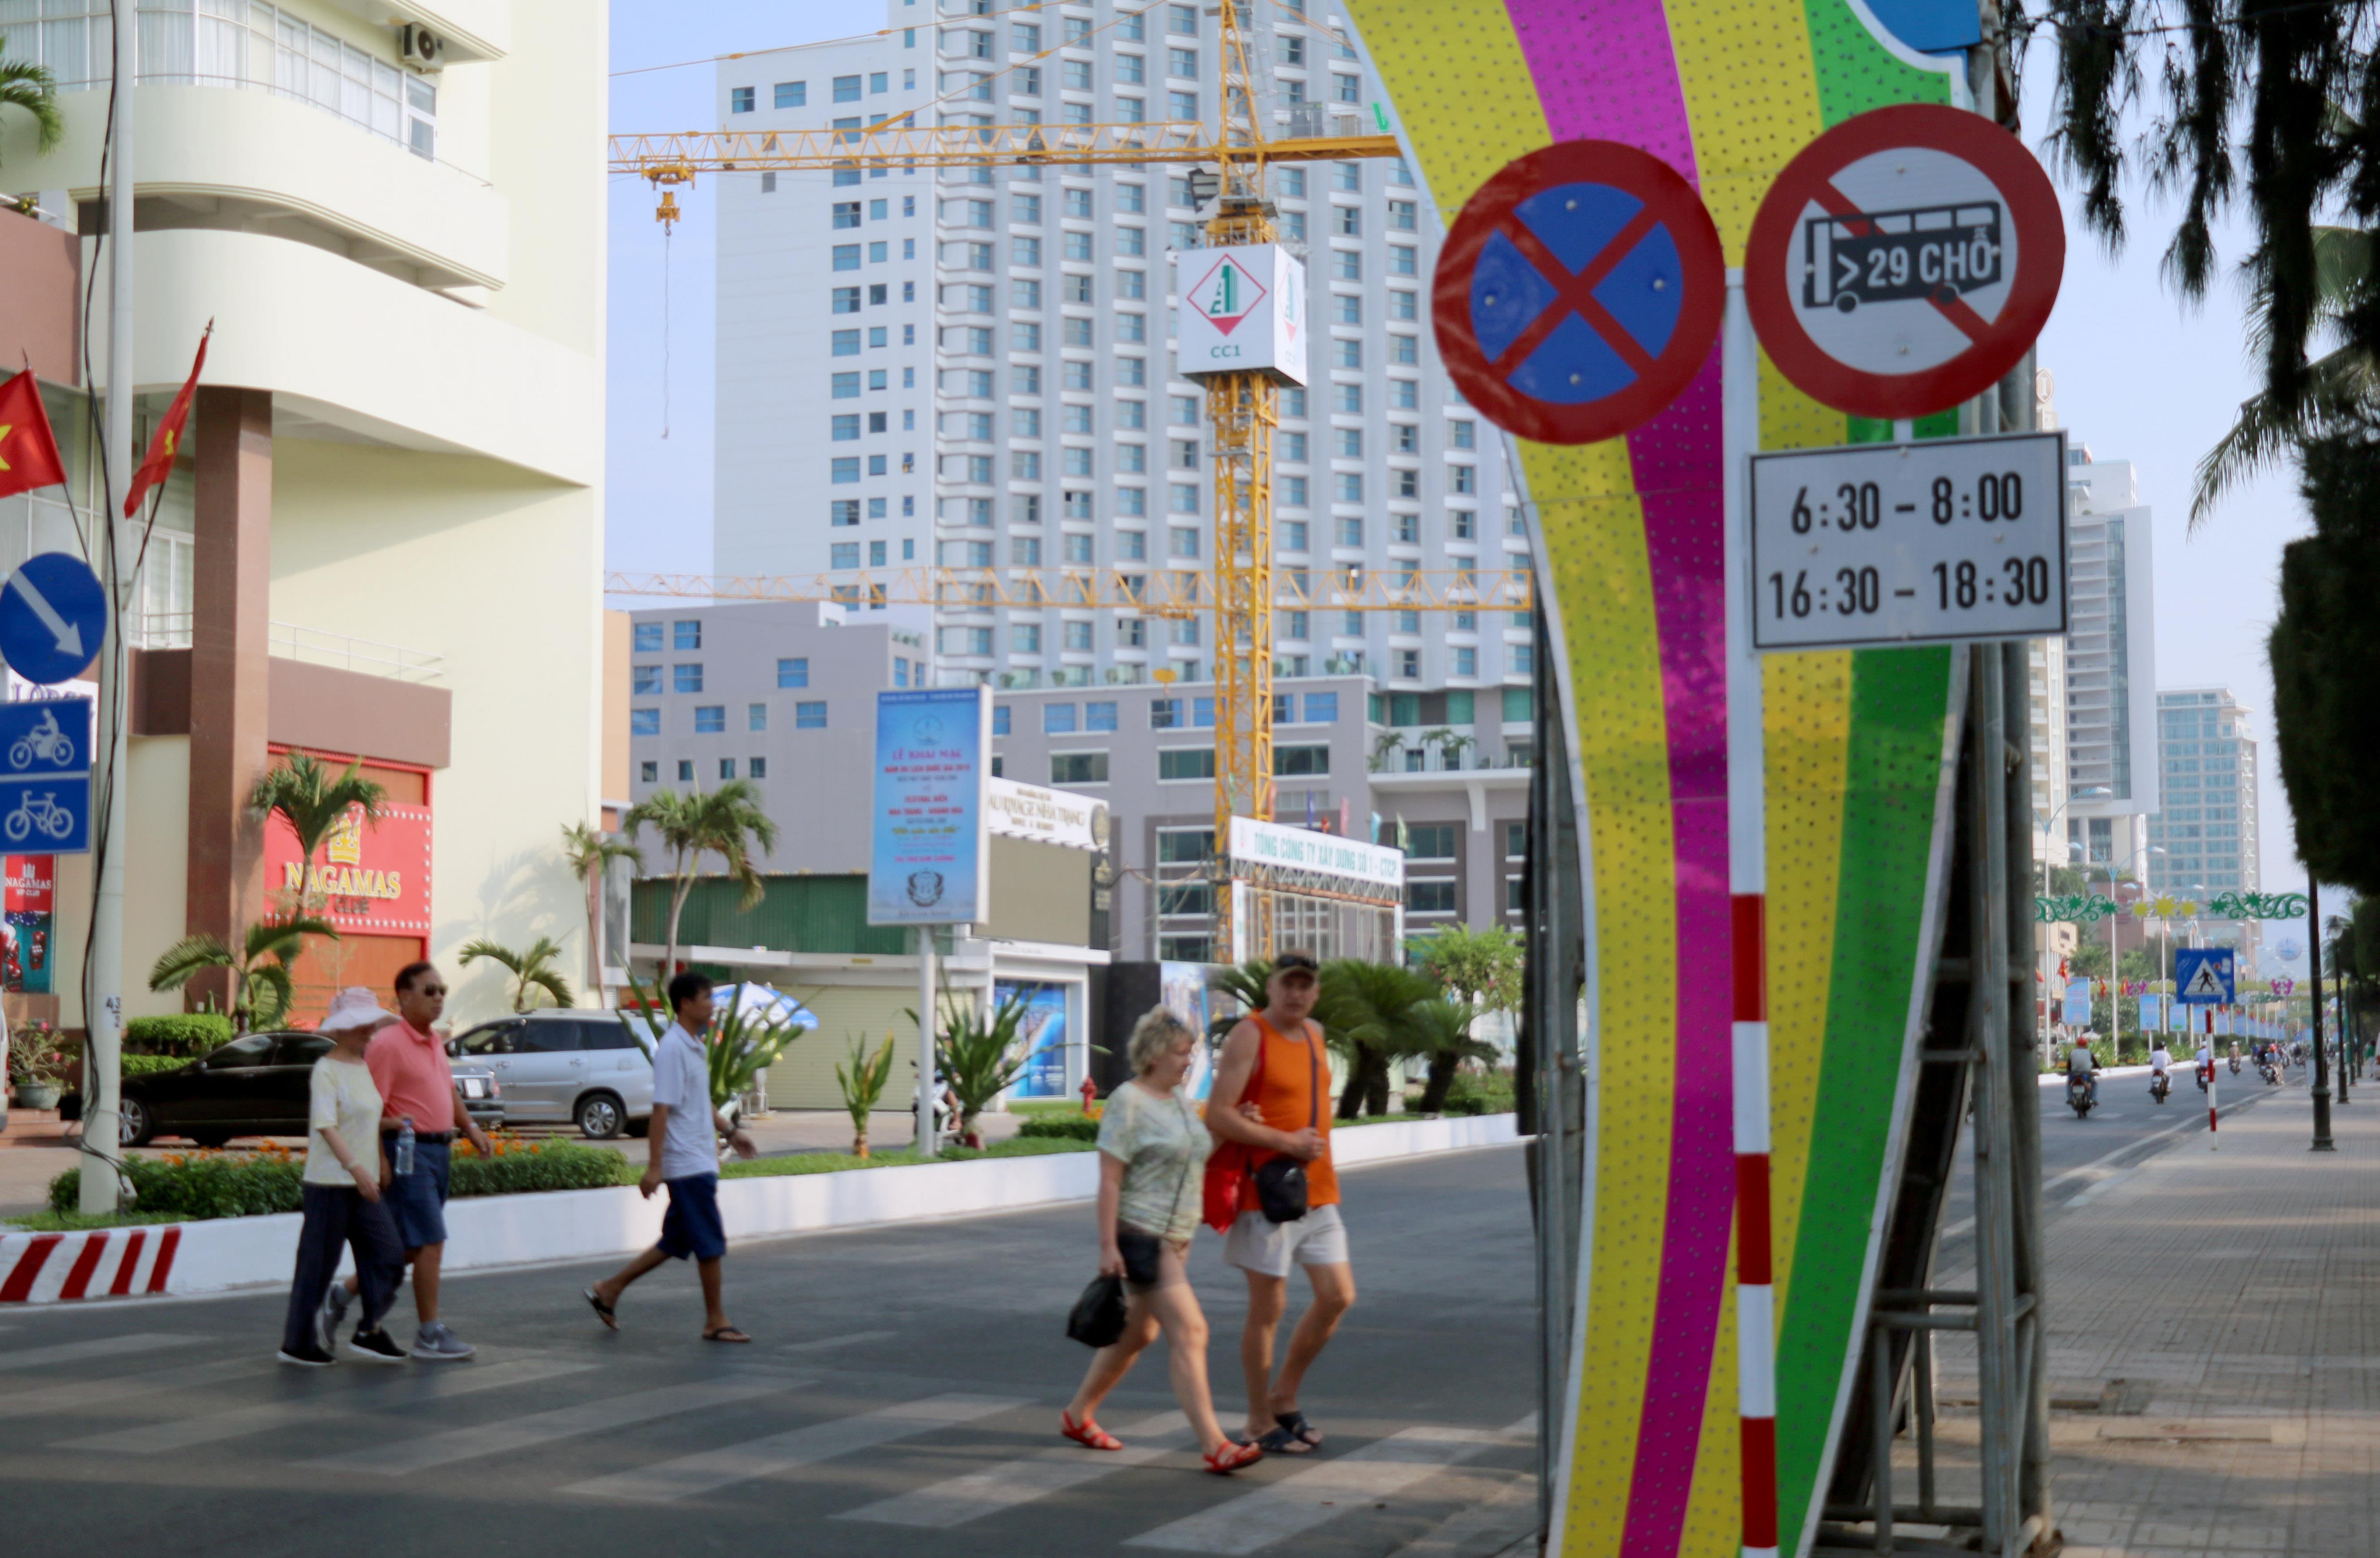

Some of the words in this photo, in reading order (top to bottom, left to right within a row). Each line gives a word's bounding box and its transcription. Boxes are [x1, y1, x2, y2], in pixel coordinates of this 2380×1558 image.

[1867, 246, 1909, 288] 29
[1211, 344, 1241, 358] CC1
[1792, 481, 1880, 534] 6:30
[1932, 471, 2023, 526] 8:00
[1769, 566, 1879, 619] 16:30
[1933, 555, 2048, 610] 18:30
[5, 877, 52, 889] NAGAMAS
[284, 862, 401, 898] NAGAMAS
